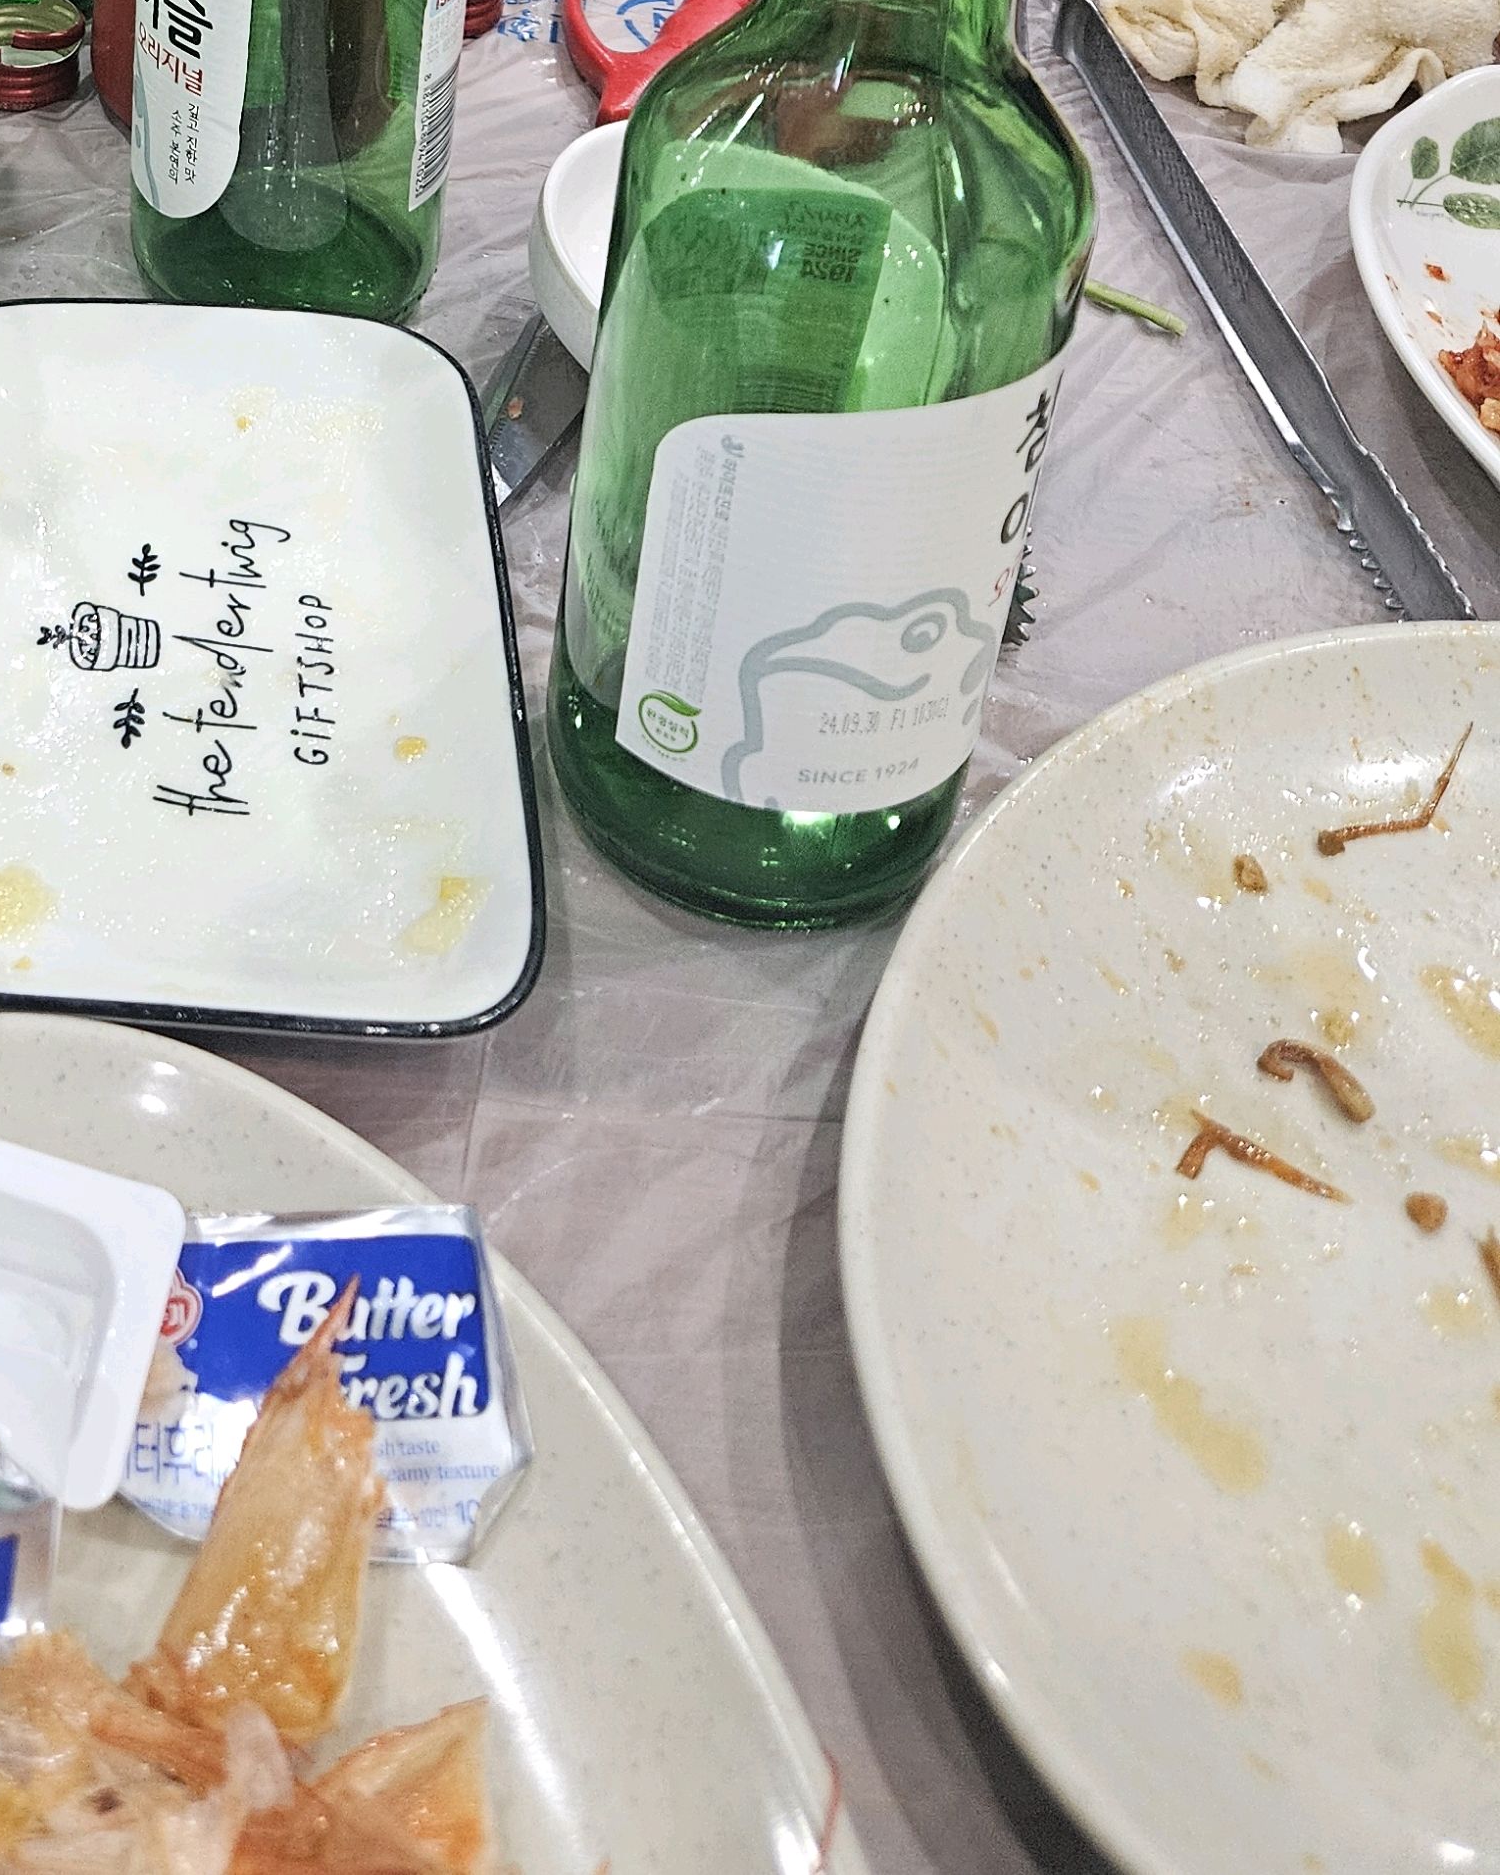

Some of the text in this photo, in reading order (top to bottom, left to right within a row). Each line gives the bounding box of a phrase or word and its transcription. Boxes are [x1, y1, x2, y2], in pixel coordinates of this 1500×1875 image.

[137, 21, 203, 96] 오리지널
[797, 757, 919, 785] SINCE 1924
[256, 1269, 477, 1347] Butter
[437, 1461, 501, 1481] texture
